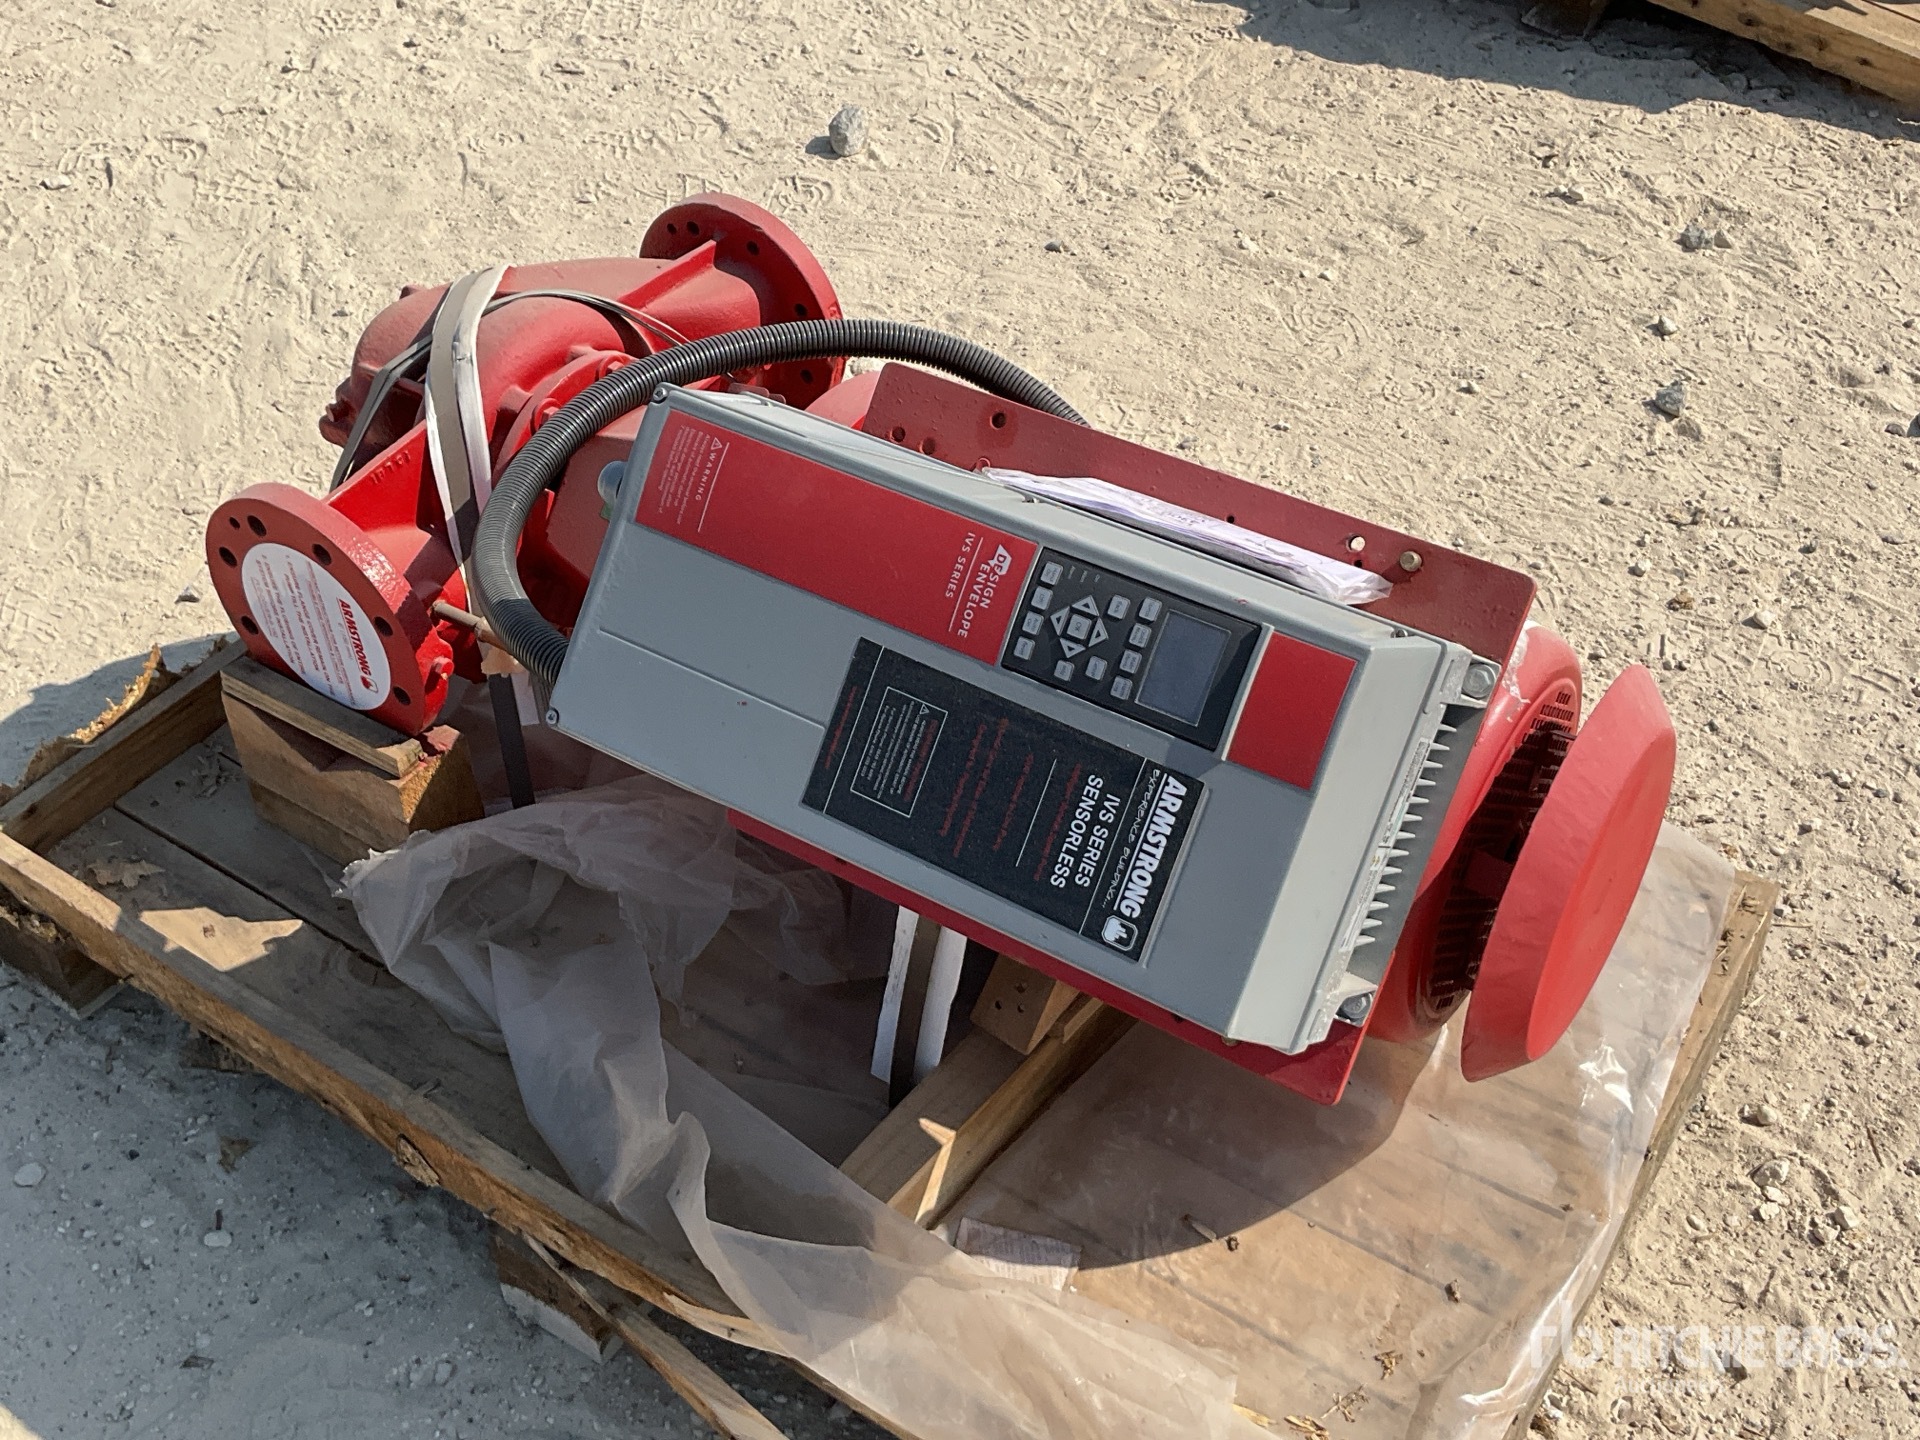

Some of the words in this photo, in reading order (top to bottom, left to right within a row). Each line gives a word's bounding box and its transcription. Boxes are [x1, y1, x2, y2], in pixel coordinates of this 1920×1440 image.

[695, 452, 716, 501] WARNING
[962, 532, 976, 552] IVS
[263, 561, 277, 590] ENSURE
[273, 592, 281, 604] THE
[289, 639, 296, 650] OF
[945, 556, 966, 598] SERIES
[958, 564, 990, 638] ENVELOPE
[979, 554, 1007, 608] DESIGN
[274, 616, 293, 663] INSTALLATION
[283, 573, 294, 594] PUMP
[290, 595, 299, 608] TILL
[296, 610, 304, 623] THE
[300, 625, 319, 671] INSTALLATION
[286, 561, 299, 590] ENSURE
[296, 591, 309, 619] FLANGE
[305, 619, 317, 644] COVER
[314, 644, 326, 670] REMAIN
[322, 671, 330, 682] ON
[340, 598, 372, 676] ARMSTRONG
[1074, 621, 1082, 631] OK
[1050, 774, 1103, 888] SENSORLESS
[1099, 794, 1120, 823] IVS
[1128, 769, 1160, 843] EXPERIENCE
[1074, 825, 1109, 887] SERIES
[1120, 776, 1187, 918] ARMSTRONG
